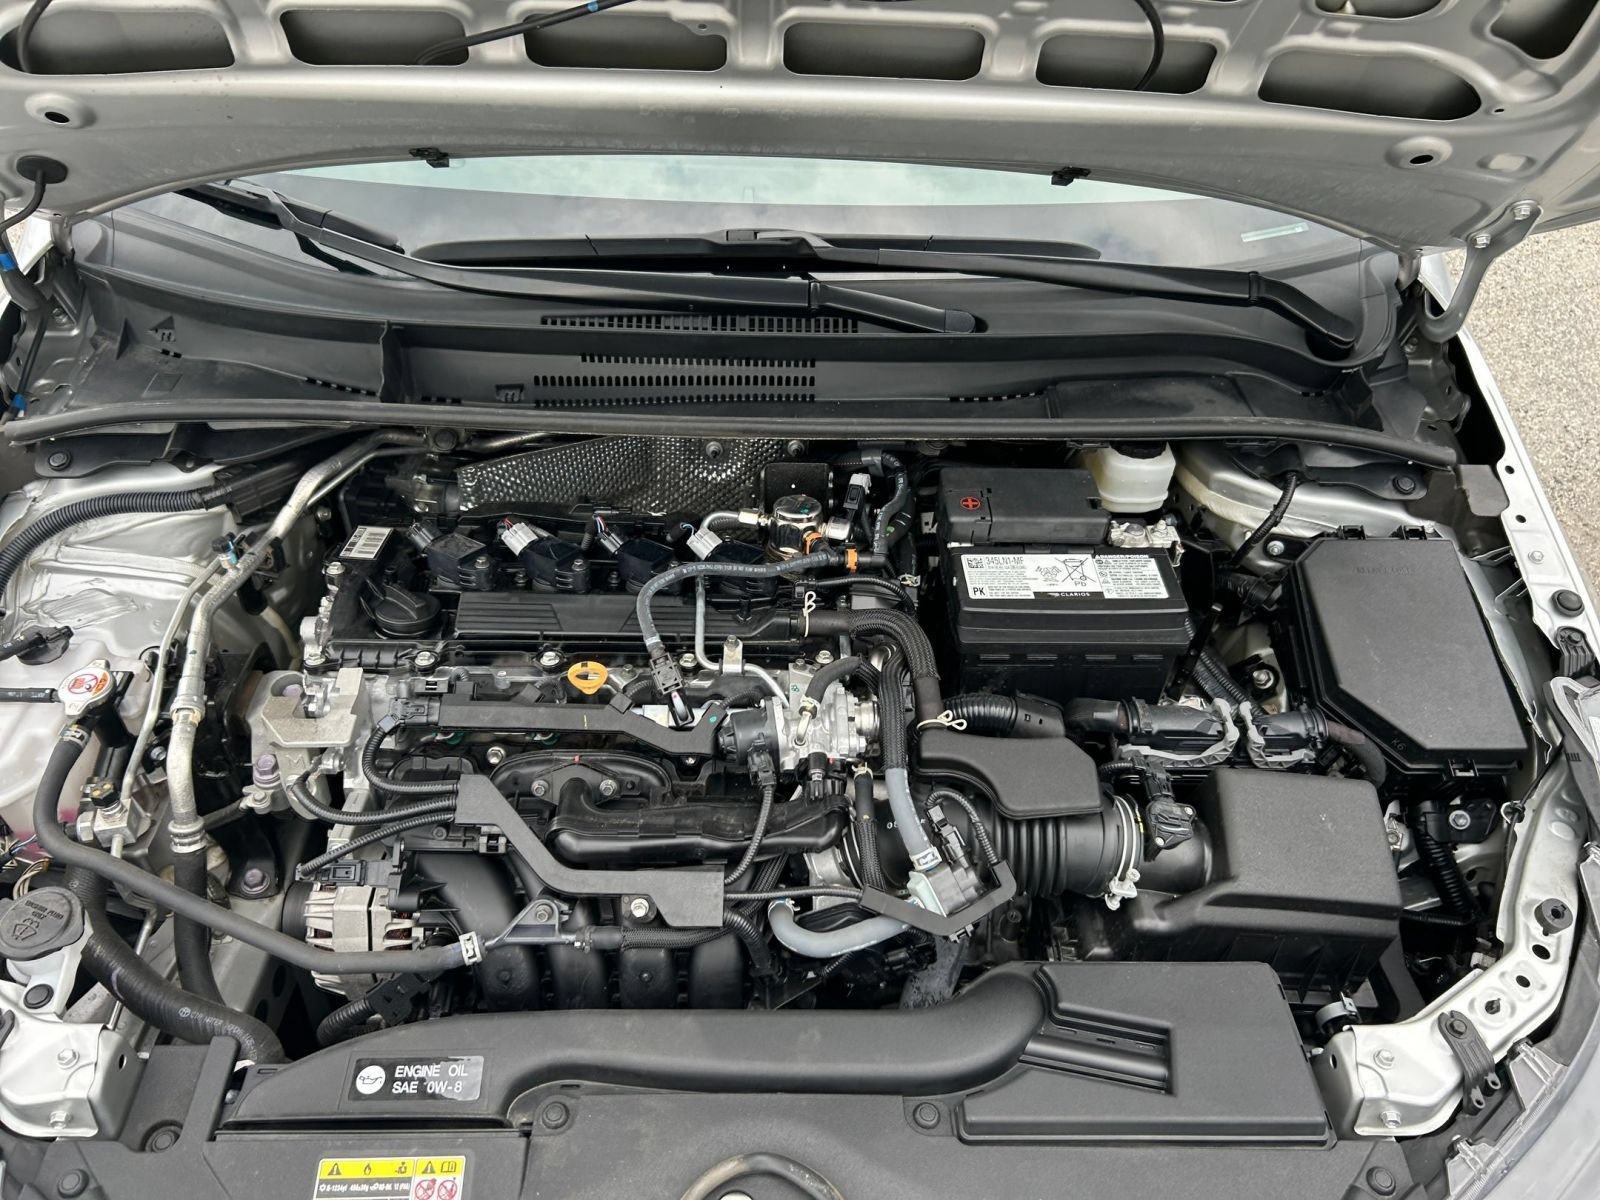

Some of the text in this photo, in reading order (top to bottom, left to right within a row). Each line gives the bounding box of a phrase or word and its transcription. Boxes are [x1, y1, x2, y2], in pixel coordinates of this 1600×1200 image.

[973, 587, 986, 596] PK
[395, 1064, 468, 1078] ENGINE OIL
[392, 1081, 462, 1093] SAE 0W-8
